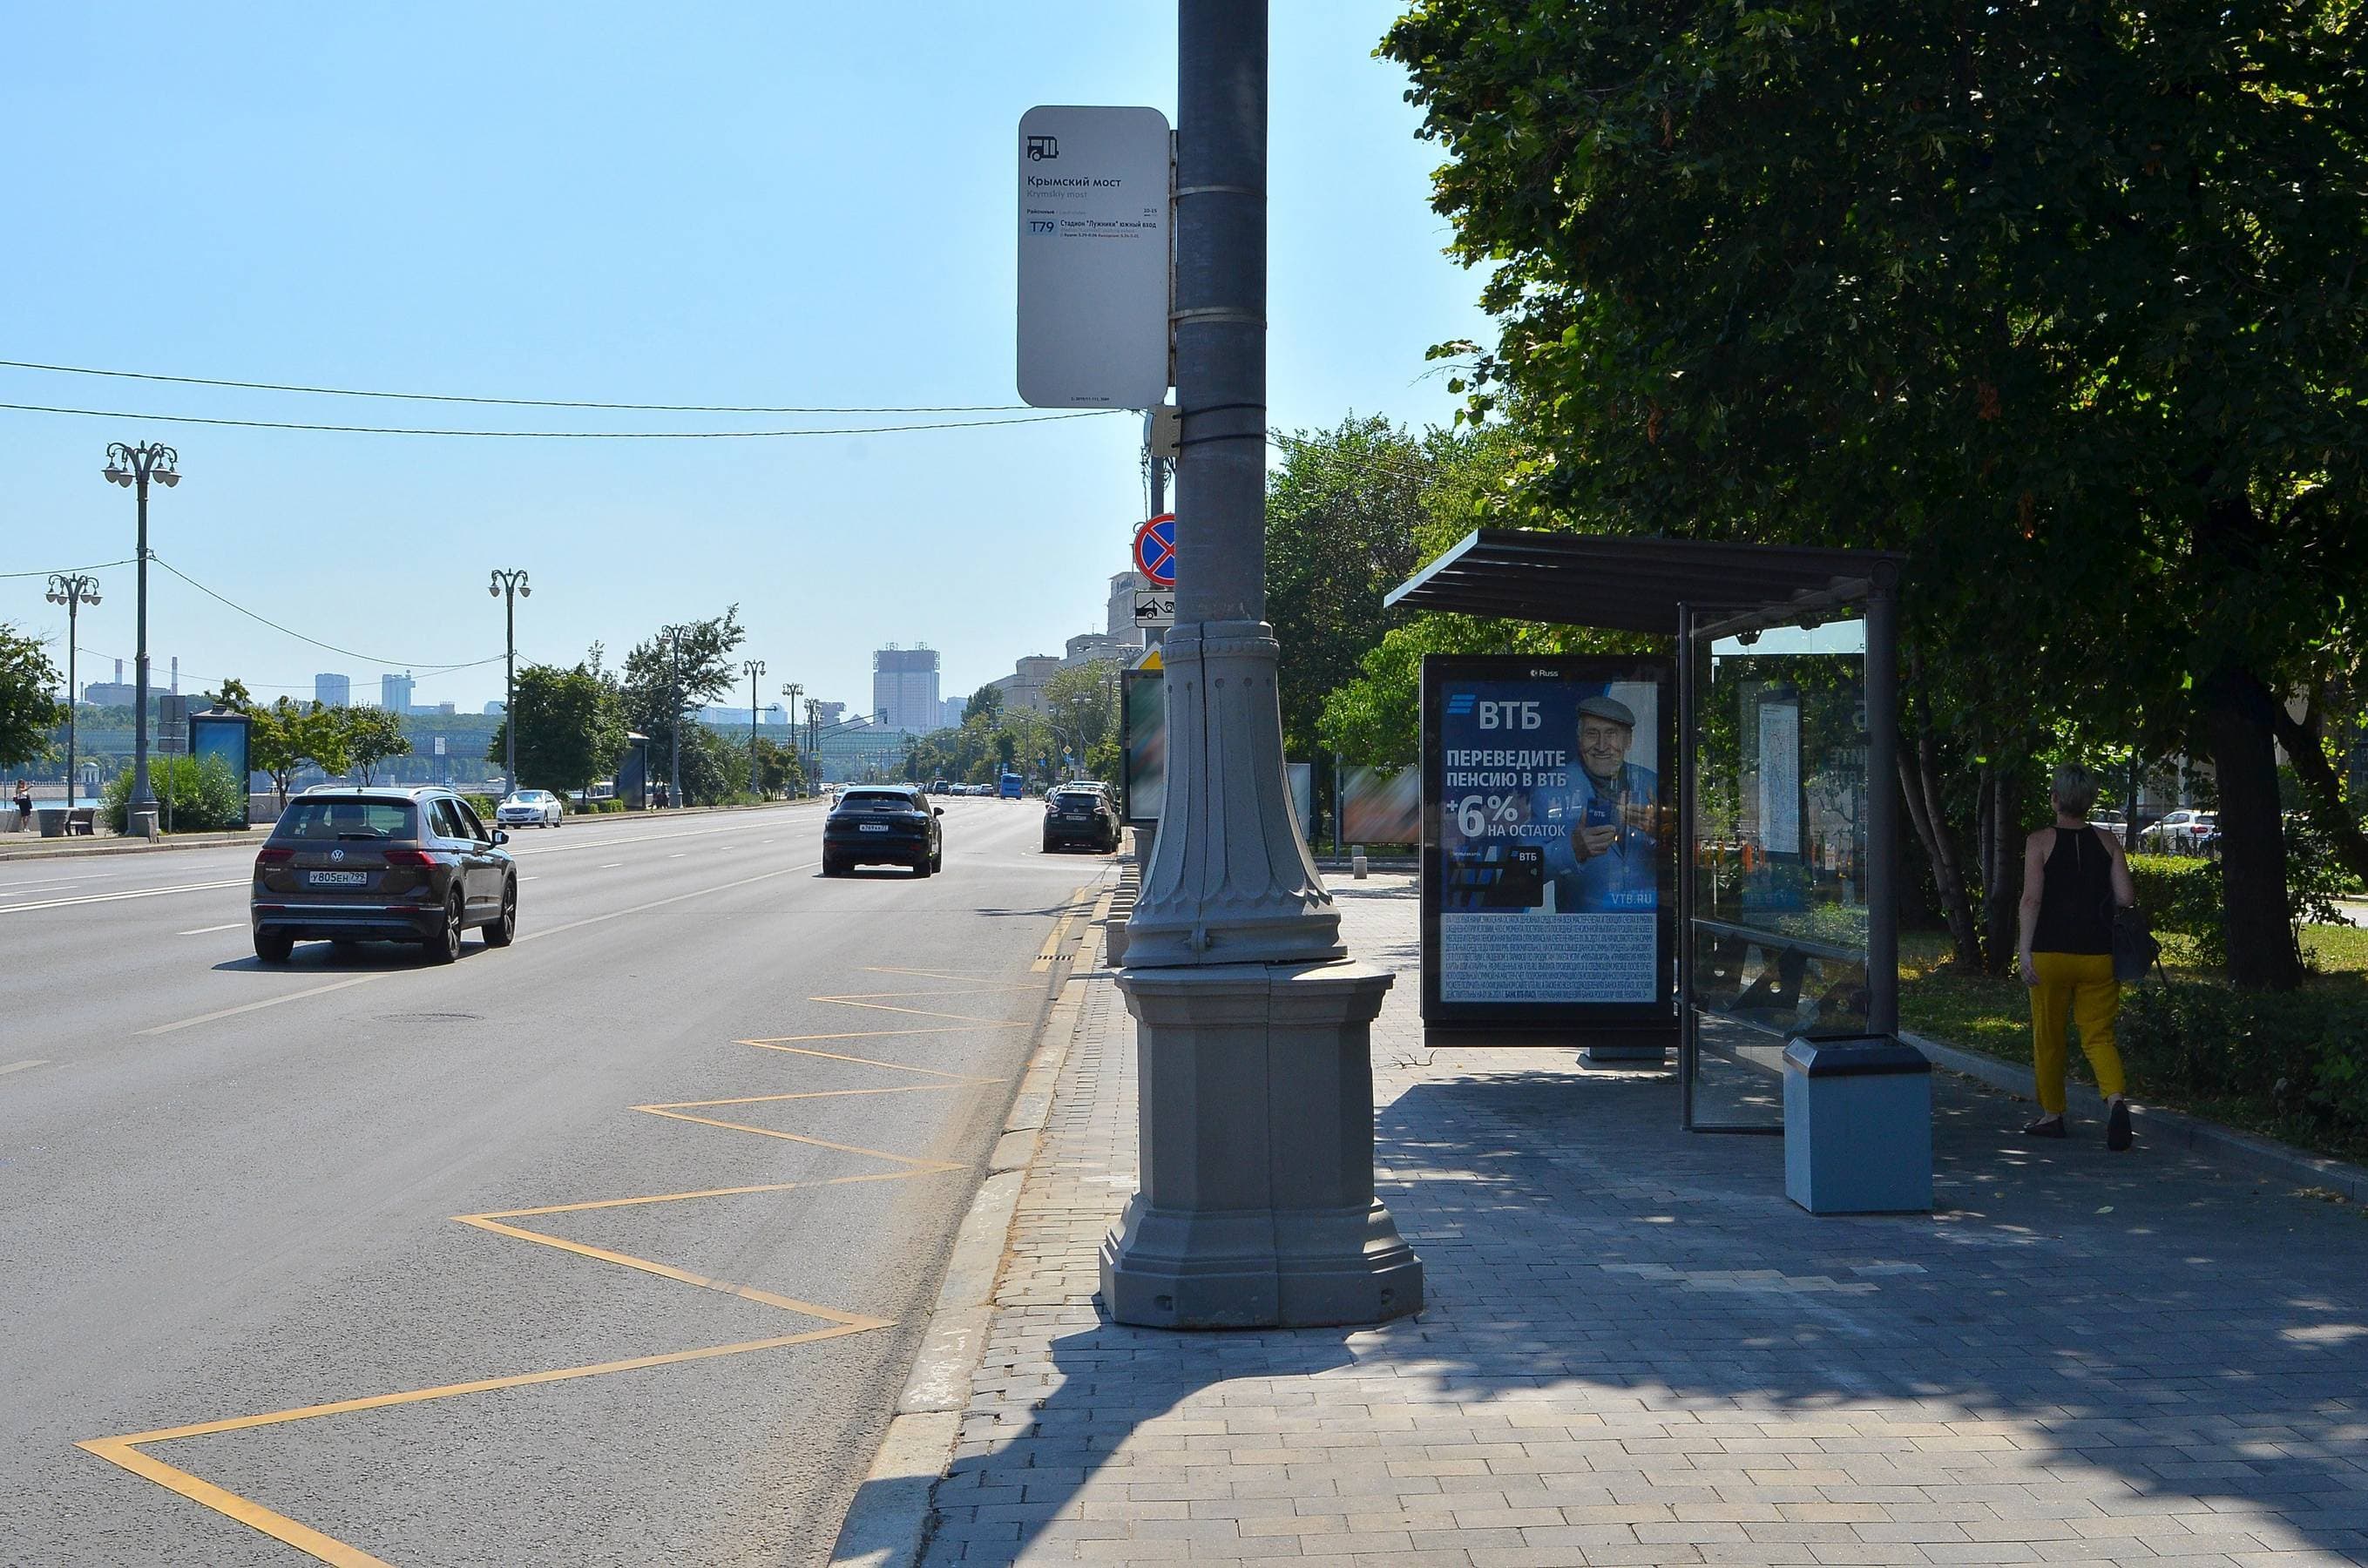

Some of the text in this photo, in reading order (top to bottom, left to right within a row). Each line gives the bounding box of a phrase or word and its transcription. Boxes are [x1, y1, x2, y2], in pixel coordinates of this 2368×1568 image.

[1027, 176, 1089, 188] Крымский
[1026, 190, 1065, 199] Krymskiy
[1479, 700, 1542, 730] ВТБ
[1446, 750, 1566, 770] ПЕРЕВЕДИТЕ
[1446, 772, 1567, 787] ПЕНСИЮ В ВТБ
[1488, 824, 1566, 836] НА ОСТАТОК
[1519, 852, 1538, 862] ВТБ
[1611, 893, 1652, 905] VTB.RU
